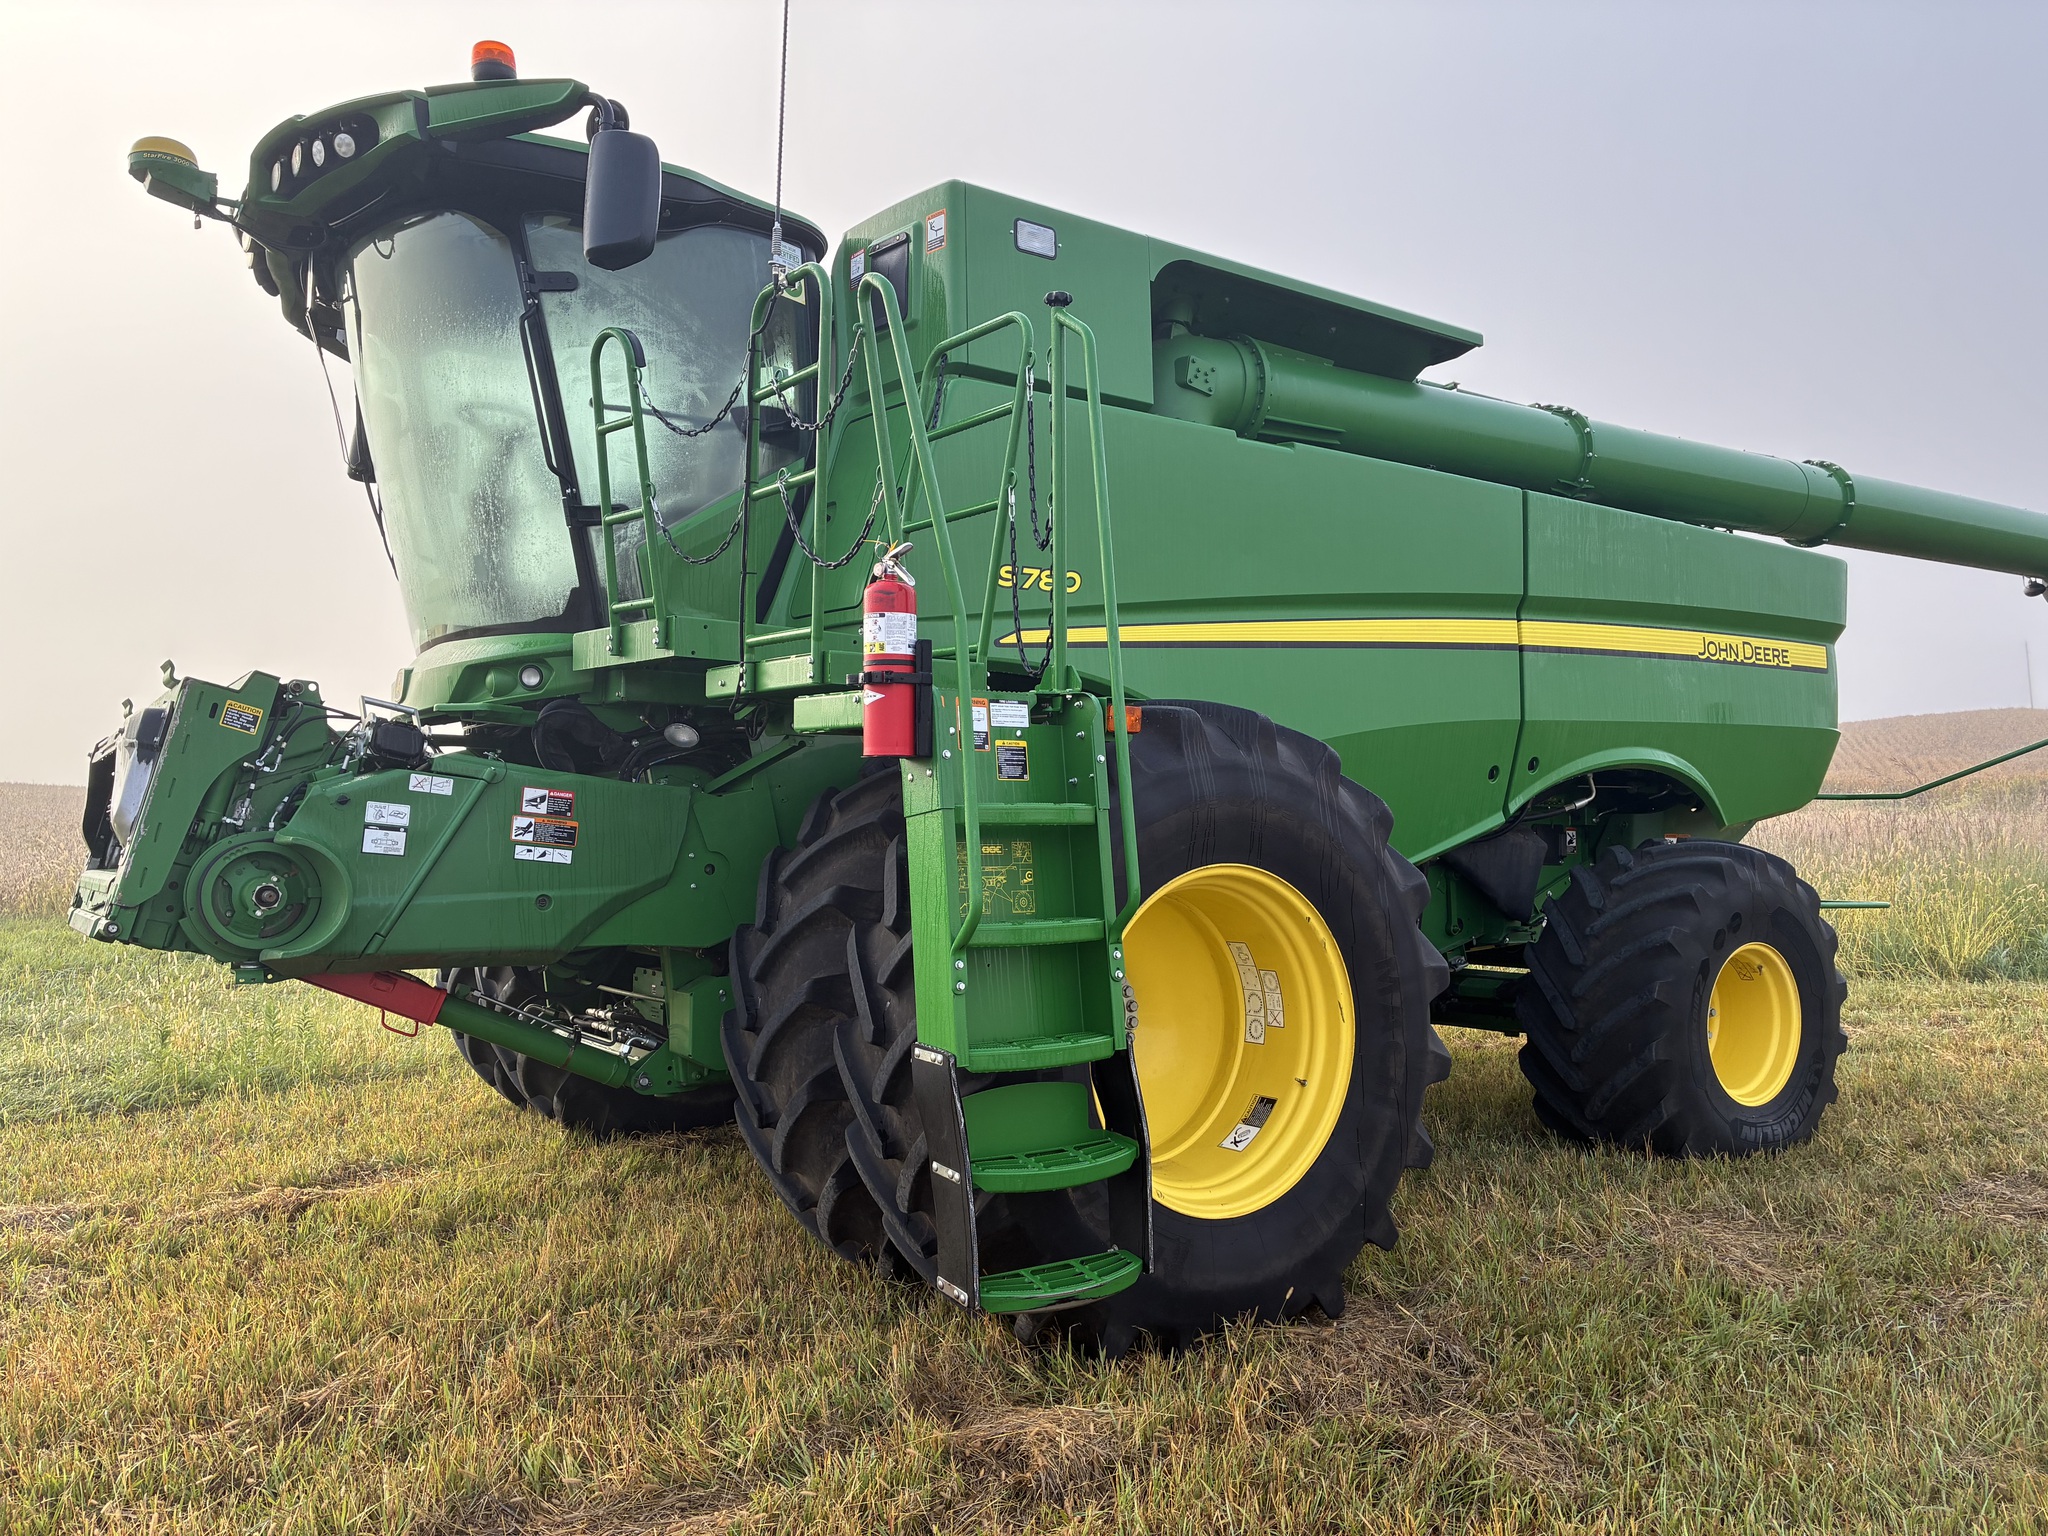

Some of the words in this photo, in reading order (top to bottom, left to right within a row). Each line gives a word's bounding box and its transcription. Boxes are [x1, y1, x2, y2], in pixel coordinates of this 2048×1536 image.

[143, 152, 171, 160] StarFire
[173, 156, 189, 166] 3000
[998, 564, 1082, 594] S780
[1698, 636, 1739, 659] JOHN
[1742, 641, 1790, 664] DEERE
[233, 703, 262, 714] CAUTION
[1740, 1087, 1813, 1142] MICHELIN
